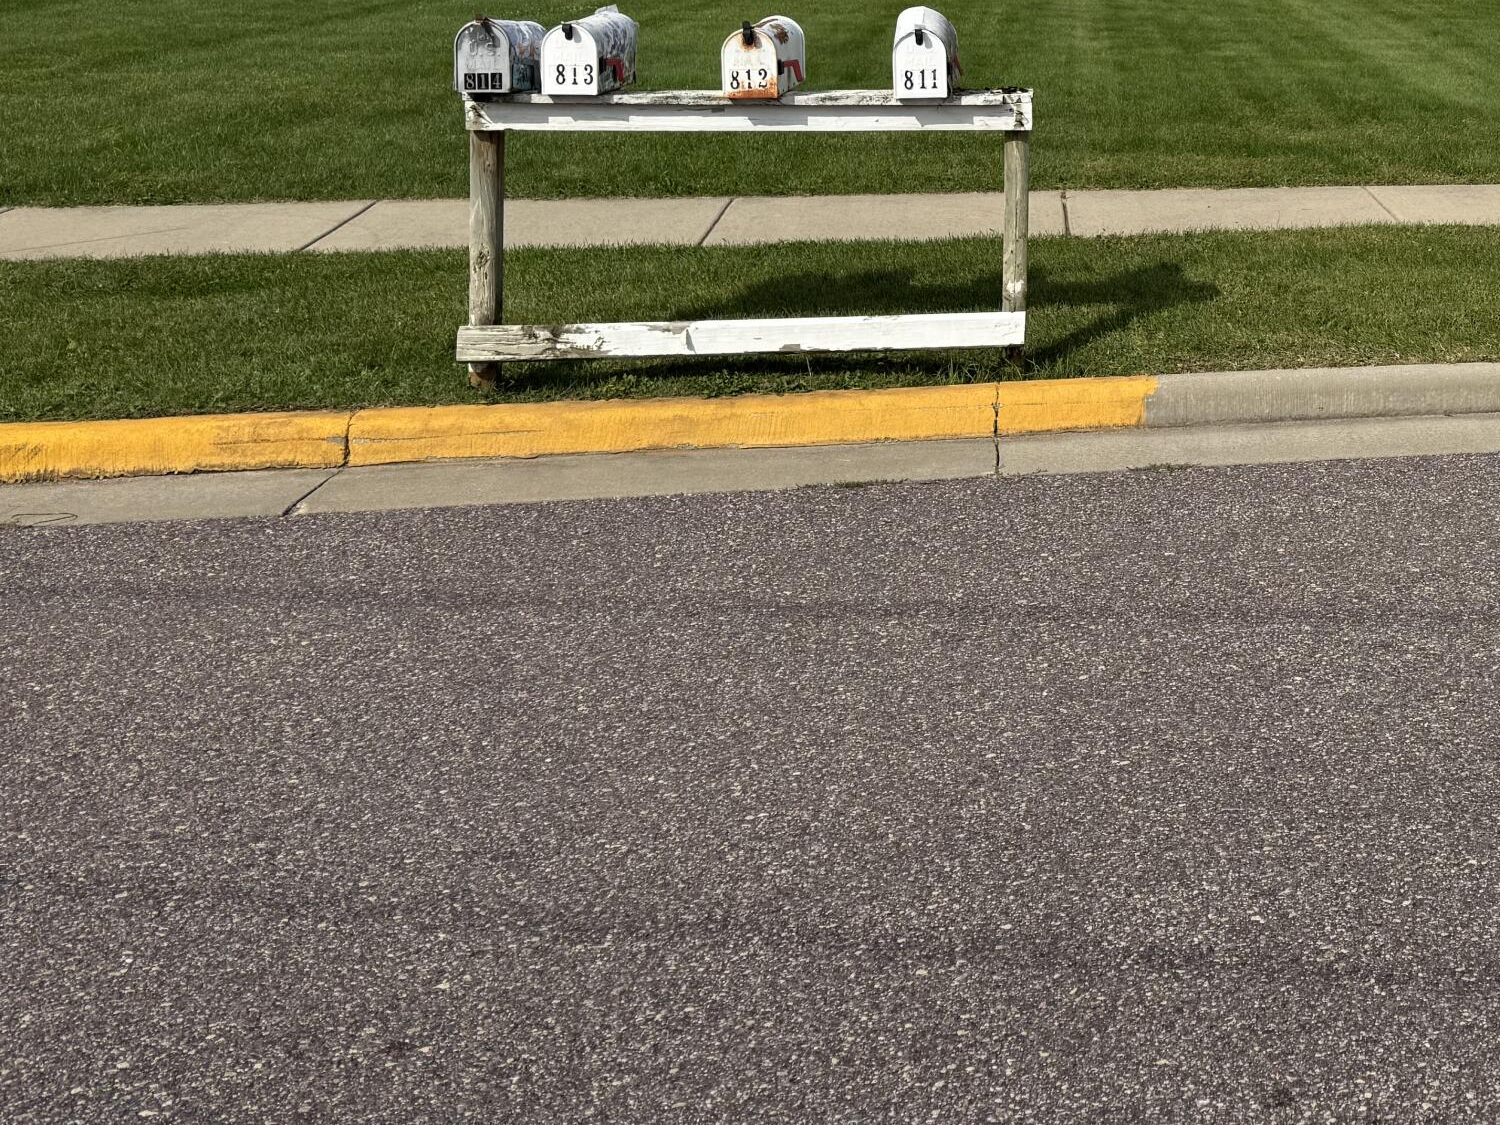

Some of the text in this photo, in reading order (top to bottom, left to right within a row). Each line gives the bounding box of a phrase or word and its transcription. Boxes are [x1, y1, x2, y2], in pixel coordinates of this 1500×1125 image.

[465, 73, 502, 90] 814
[556, 64, 593, 85] 813
[730, 68, 768, 89] 812
[904, 69, 938, 90] 811
